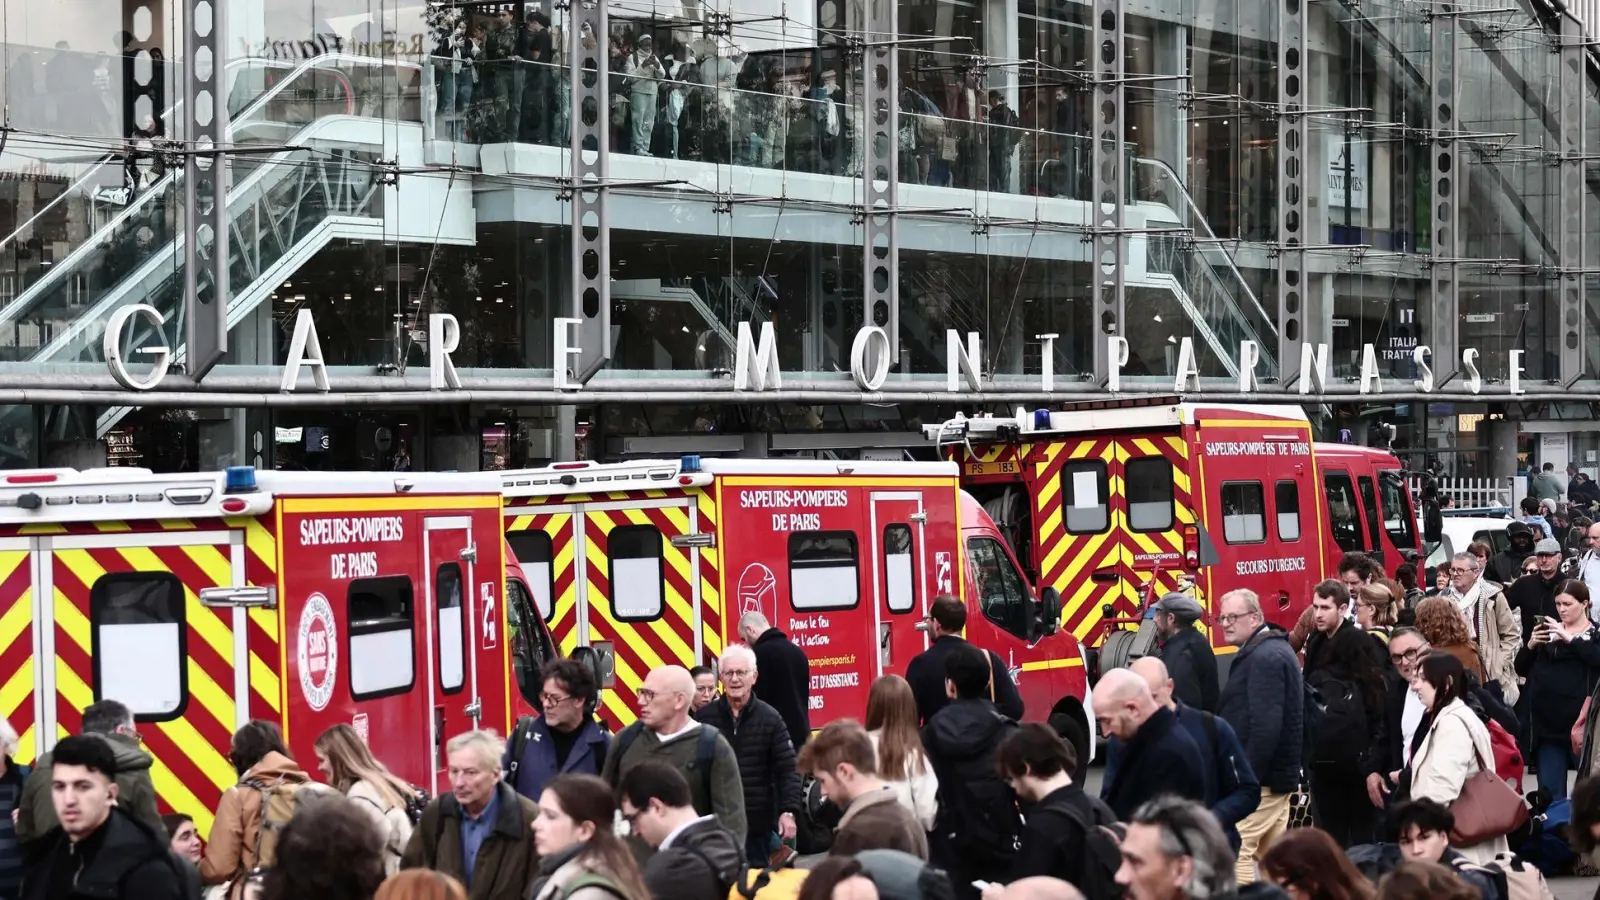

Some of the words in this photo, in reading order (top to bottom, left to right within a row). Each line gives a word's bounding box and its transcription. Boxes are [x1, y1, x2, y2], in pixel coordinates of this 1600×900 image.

[1400, 308, 1414, 324] IT
[104, 304, 583, 390] GARE
[734, 321, 1525, 394] MONTPARNASSE
[1390, 337, 1417, 347] ITALIA
[1206, 442, 1276, 456] SAPEURS-POMPIERS
[1279, 443, 1288, 455] DE
[1291, 442, 1310, 455] PARIS
[972, 464, 983, 473] PS
[999, 463, 1013, 472] 183
[740, 490, 848, 508] SAPEURS-POMPIERS
[772, 514, 788, 530] DE
[790, 513, 820, 530] PARIS
[300, 516, 403, 545] SAPEURS-POMPIERS
[331, 554, 346, 579] DE
[348, 552, 377, 577] PARIS
[1236, 560, 1268, 575] SECOURS
[1269, 557, 1305, 572] D'URGENCE
[790, 618, 808, 630] Dans
[810, 616, 817, 628] le
[818, 616, 829, 628] feu
[792, 635, 799, 646] de
[802, 634, 830, 646] l'action
[812, 676, 819, 689] ET
[820, 672, 859, 689] D'ASSISTANCE
